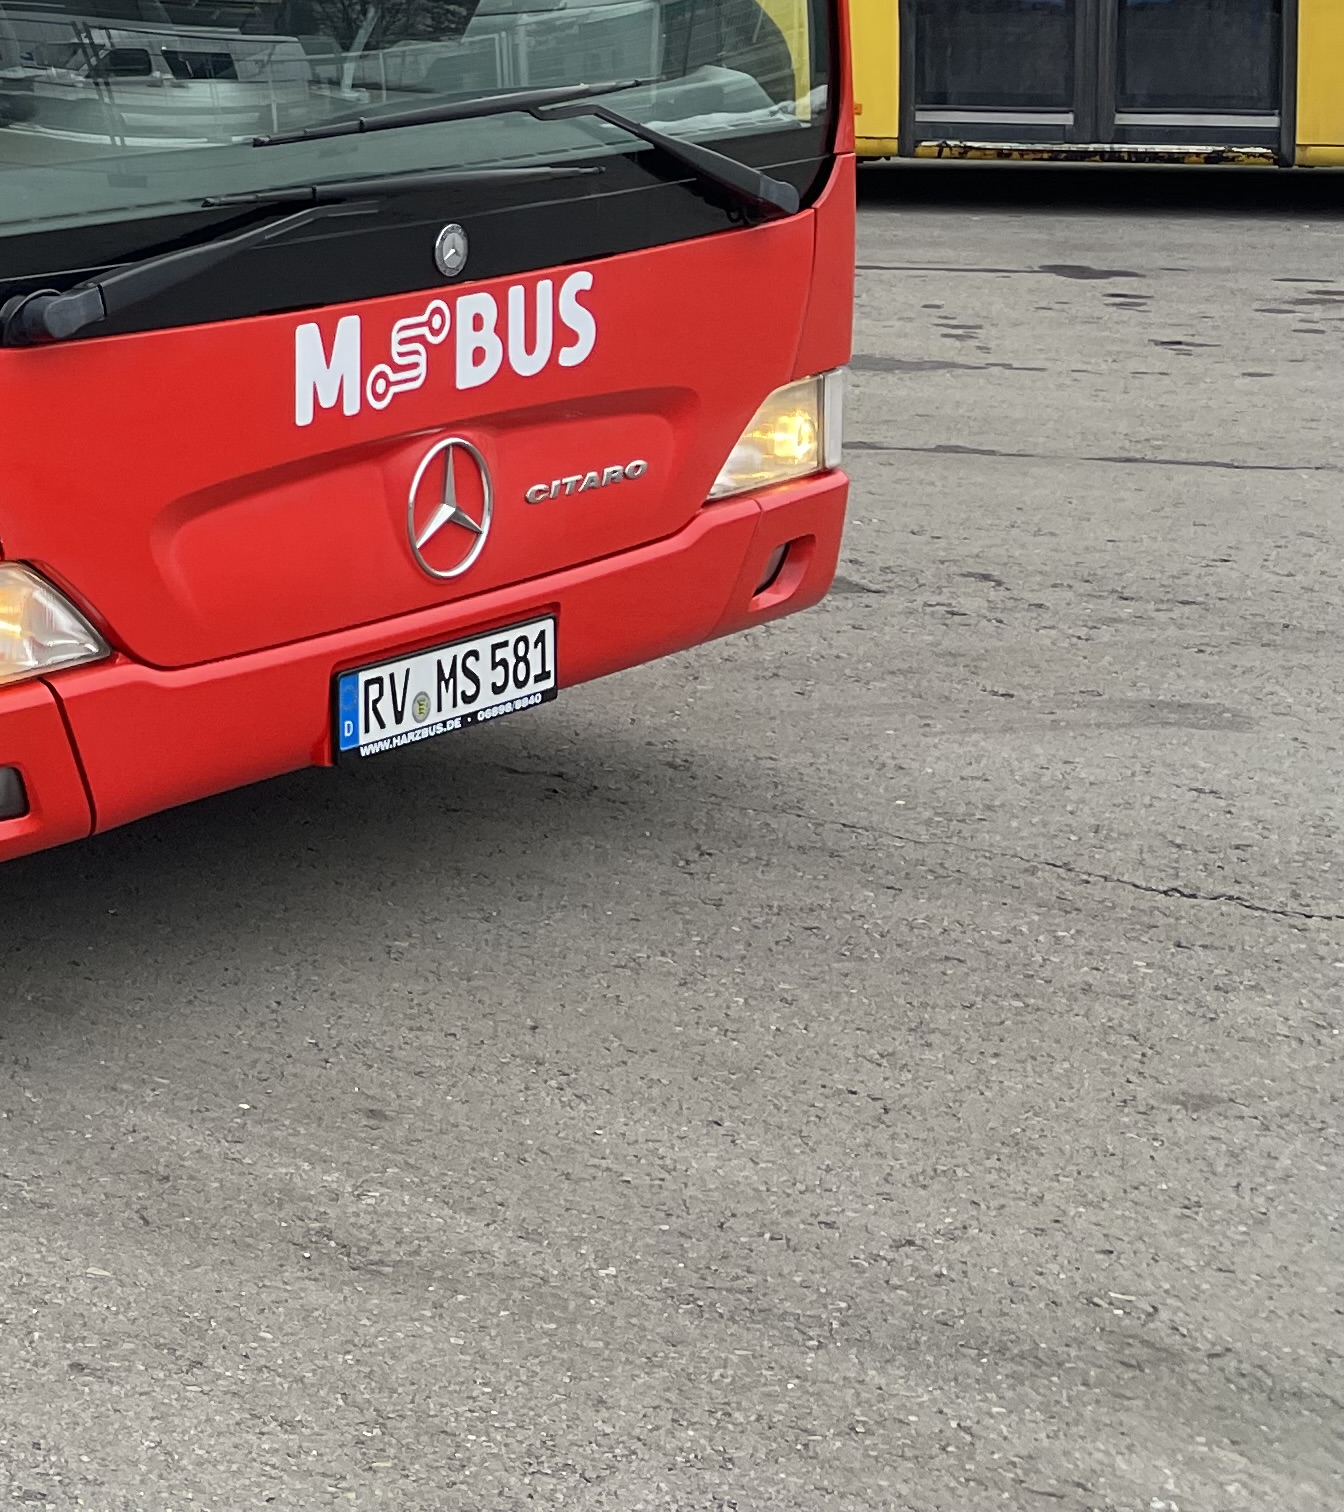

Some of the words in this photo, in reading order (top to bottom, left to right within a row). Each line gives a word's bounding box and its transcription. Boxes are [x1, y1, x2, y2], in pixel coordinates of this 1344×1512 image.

[524, 459, 648, 504] CITARO
[363, 667, 410, 734] RV
[436, 648, 481, 713] MS
[490, 628, 552, 696] 581
[344, 720, 353, 738] D
